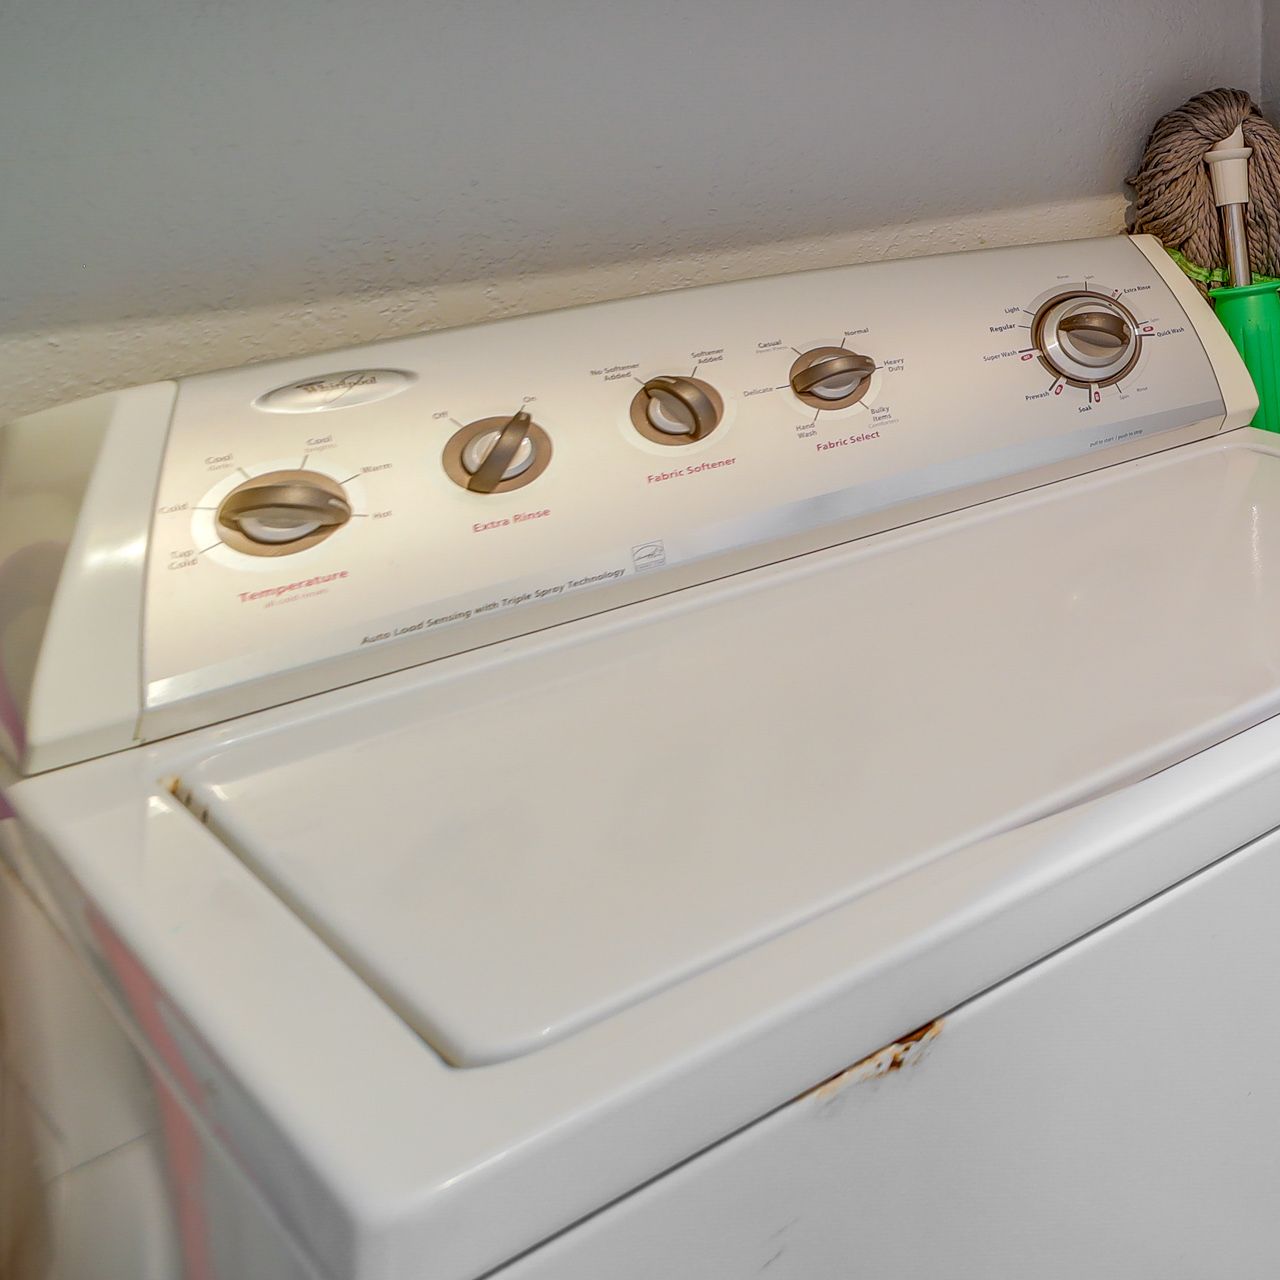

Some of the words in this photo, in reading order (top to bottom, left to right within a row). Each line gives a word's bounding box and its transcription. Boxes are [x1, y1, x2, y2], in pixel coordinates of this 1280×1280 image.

[1123, 287, 1136, 295] Extra
[1136, 283, 1151, 293] Rinse
[1004, 306, 1020, 315] Light
[844, 327, 869, 337] Normal
[989, 323, 1016, 334] Regular
[1156, 329, 1171, 338] Quick
[1171, 326, 1185, 335] Wash
[757, 339, 783, 349] Casual
[691, 347, 725, 360] Softener
[983, 352, 1000, 363] Super
[1001, 349, 1018, 358] Wash
[697, 354, 724, 365] Added
[883, 358, 904, 367] Heavy
[888, 365, 905, 373] Duty
[743, 386, 774, 397] Delicate
[1025, 391, 1050, 402] Prewash
[870, 405, 890, 415] Bulky
[1078, 405, 1093, 414] Soak
[872, 413, 892, 422] Items
[816, 436, 848, 451] Fabric
[849, 431, 880, 444] Select
[647, 470, 685, 484] Fabric
[687, 457, 737, 475] Softener
[472, 519, 511, 533] Extra
[513, 508, 551, 524] Rinse
[239, 570, 349, 602] Temperature
[361, 632, 391, 646] Auto
[393, 620, 425, 637] Load
[426, 607, 472, 629] Sensing
[474, 599, 500, 615] with
[502, 591, 533, 608] Triple
[534, 583, 565, 599] Spray
[567, 567, 626, 589] Technology
